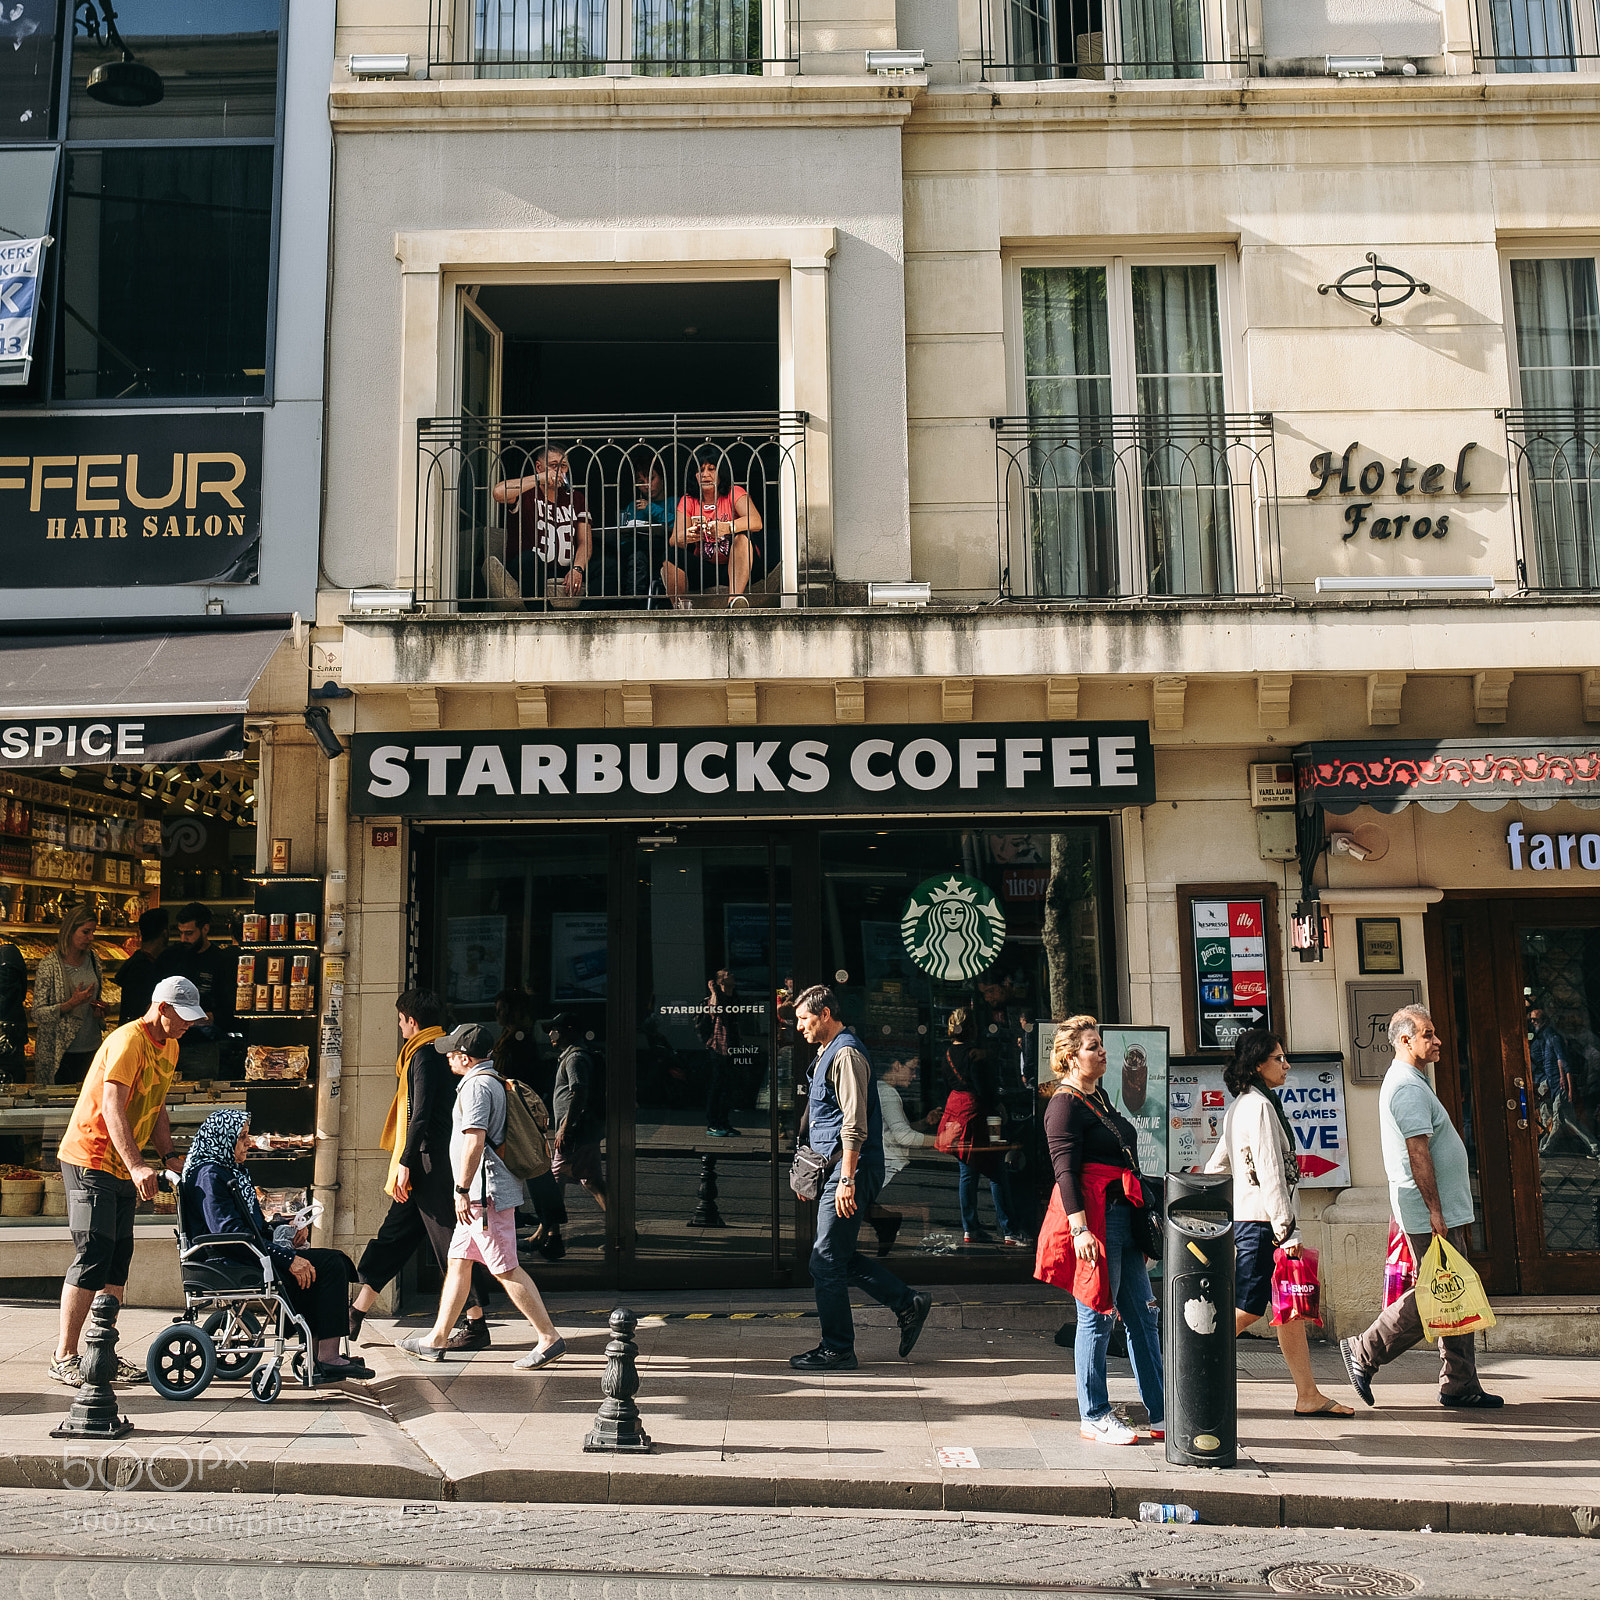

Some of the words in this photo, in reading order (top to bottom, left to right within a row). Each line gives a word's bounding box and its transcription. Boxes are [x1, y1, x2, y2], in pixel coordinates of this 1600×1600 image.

[1307, 441, 1478, 498] Hotel
[534, 498, 578, 523] TEAM
[1342, 502, 1450, 544] Faros
[46, 516, 128, 540] HAIR
[142, 514, 247, 538] SALON
[0, 723, 146, 759] SPICE
[367, 741, 831, 798] STARBUCKS
[849, 737, 1139, 795] COFFEE
[1198, 920, 1228, 929] NESPRESSO
[1236, 912, 1254, 929] illy
[660, 1005, 723, 1014] STARBUCKS
[725, 1005, 765, 1014] COFFEE
[1151, 1116, 1160, 1128] VE
[1292, 1109, 1337, 1119] GAMES
